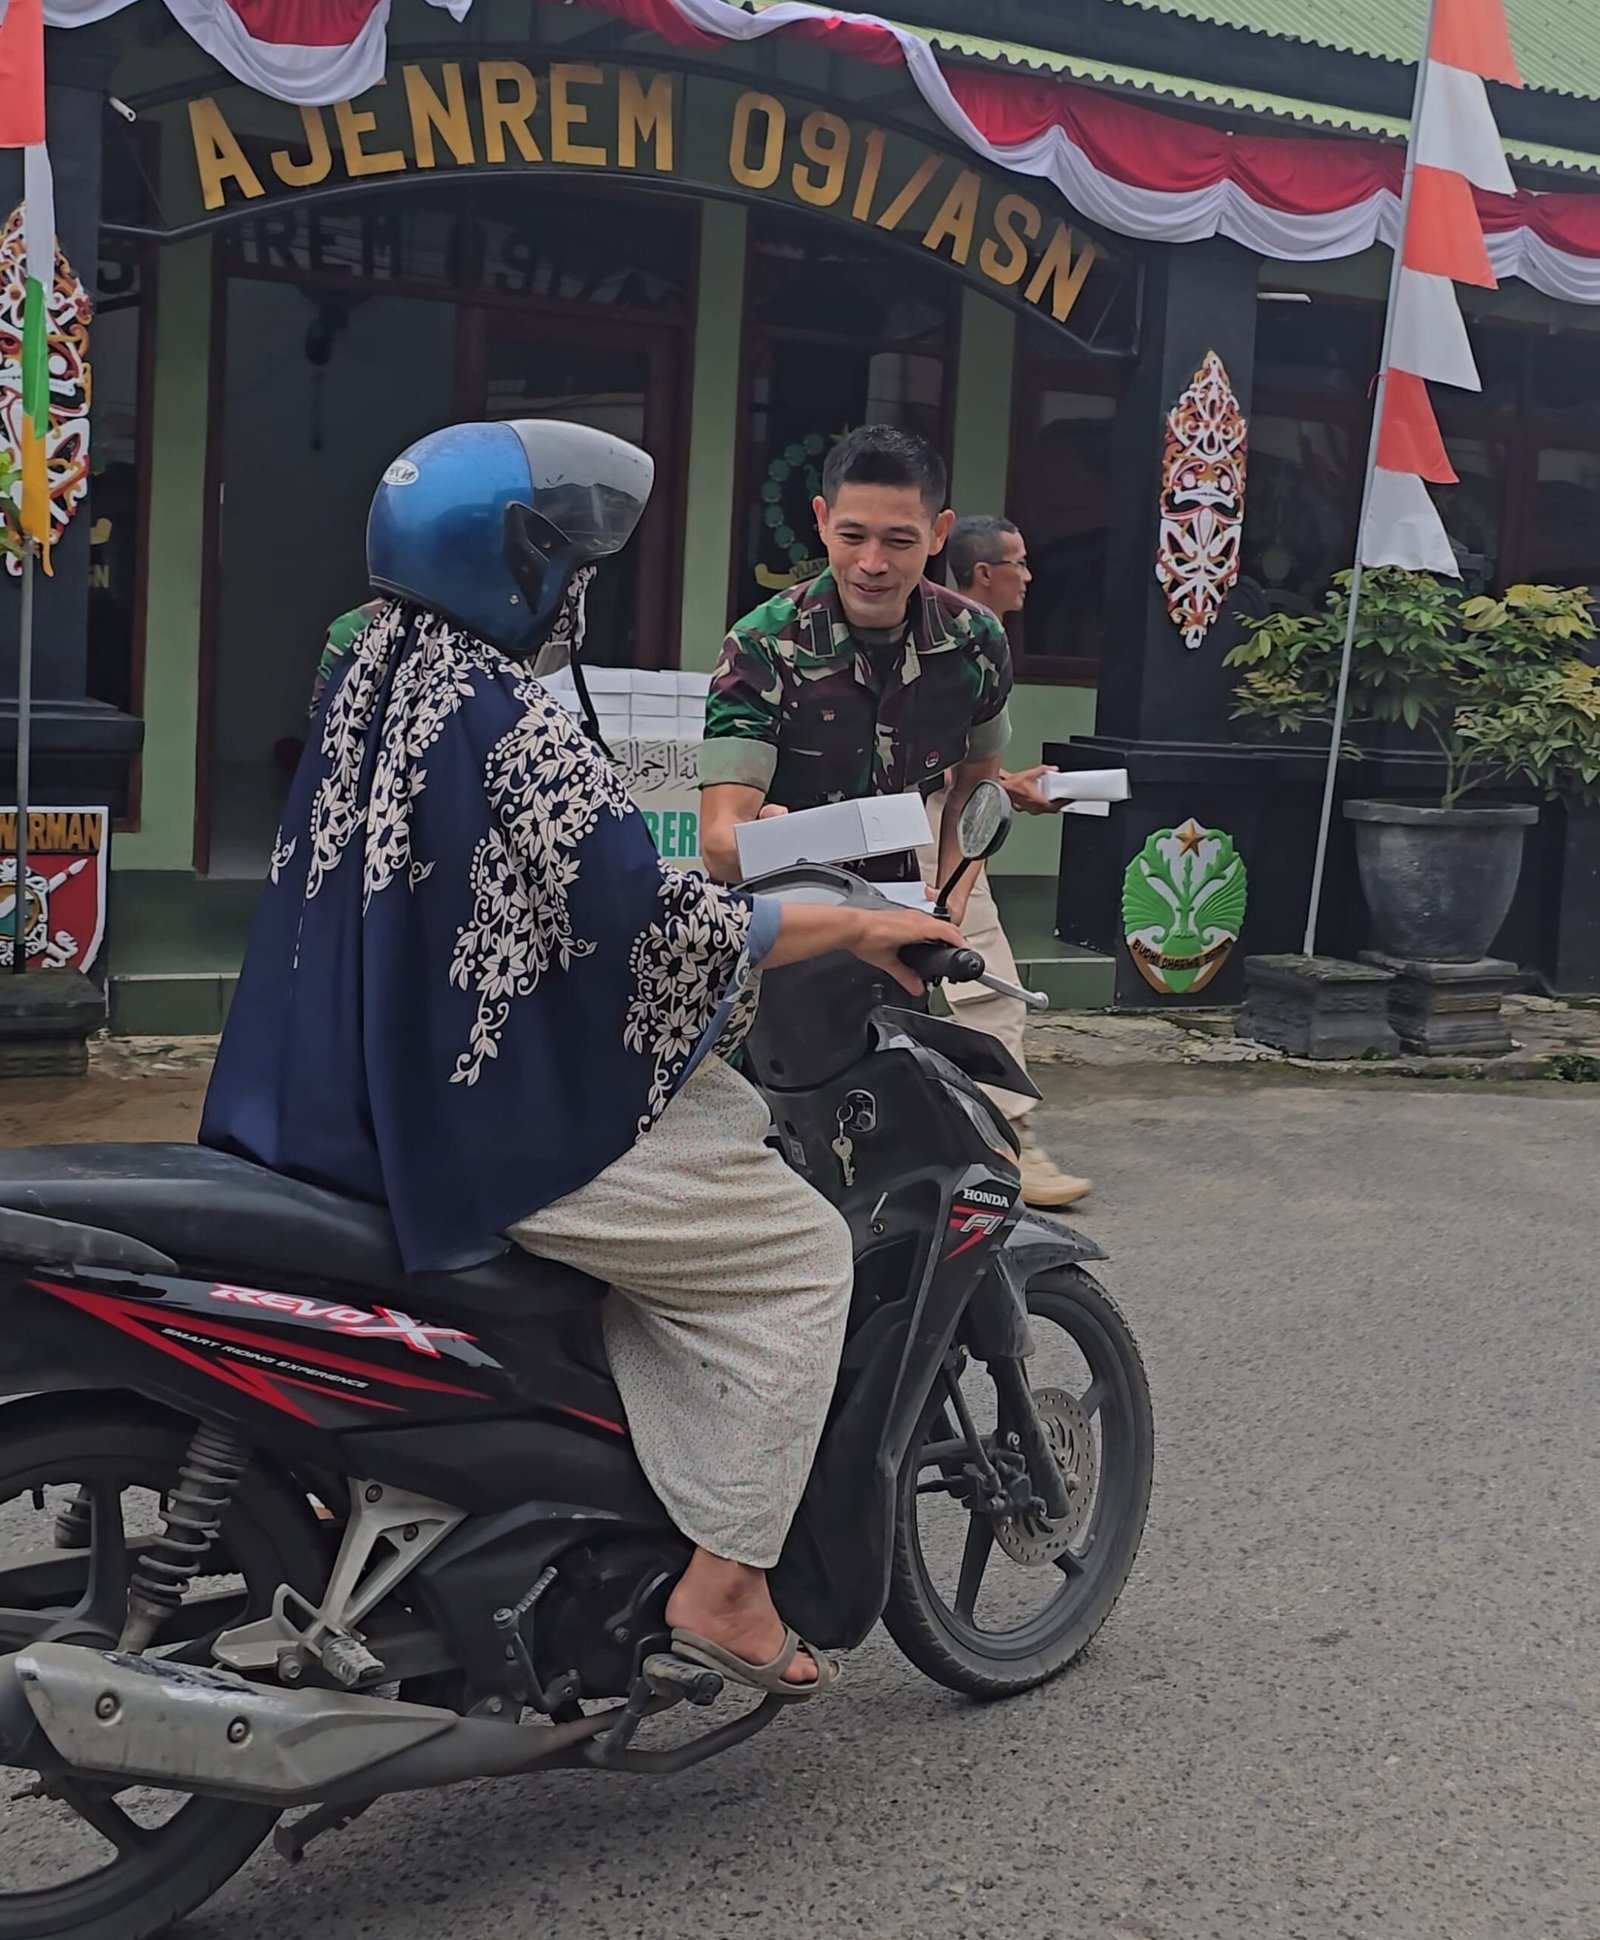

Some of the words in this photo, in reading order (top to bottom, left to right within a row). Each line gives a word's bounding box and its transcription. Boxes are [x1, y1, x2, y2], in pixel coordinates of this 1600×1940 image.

[188, 61, 673, 210] AJENREM
[729, 91, 1098, 323] 091/ASN
[641, 811, 702, 857] BER
[963, 1188, 1010, 1208] HONDA
[960, 1213, 1005, 1235] FI
[209, 1282, 379, 1324] REVO
[161, 1328, 219, 1348] SMART
[221, 1344, 276, 1364] RIDING
[276, 1360, 370, 1389] EXPERIENCE
